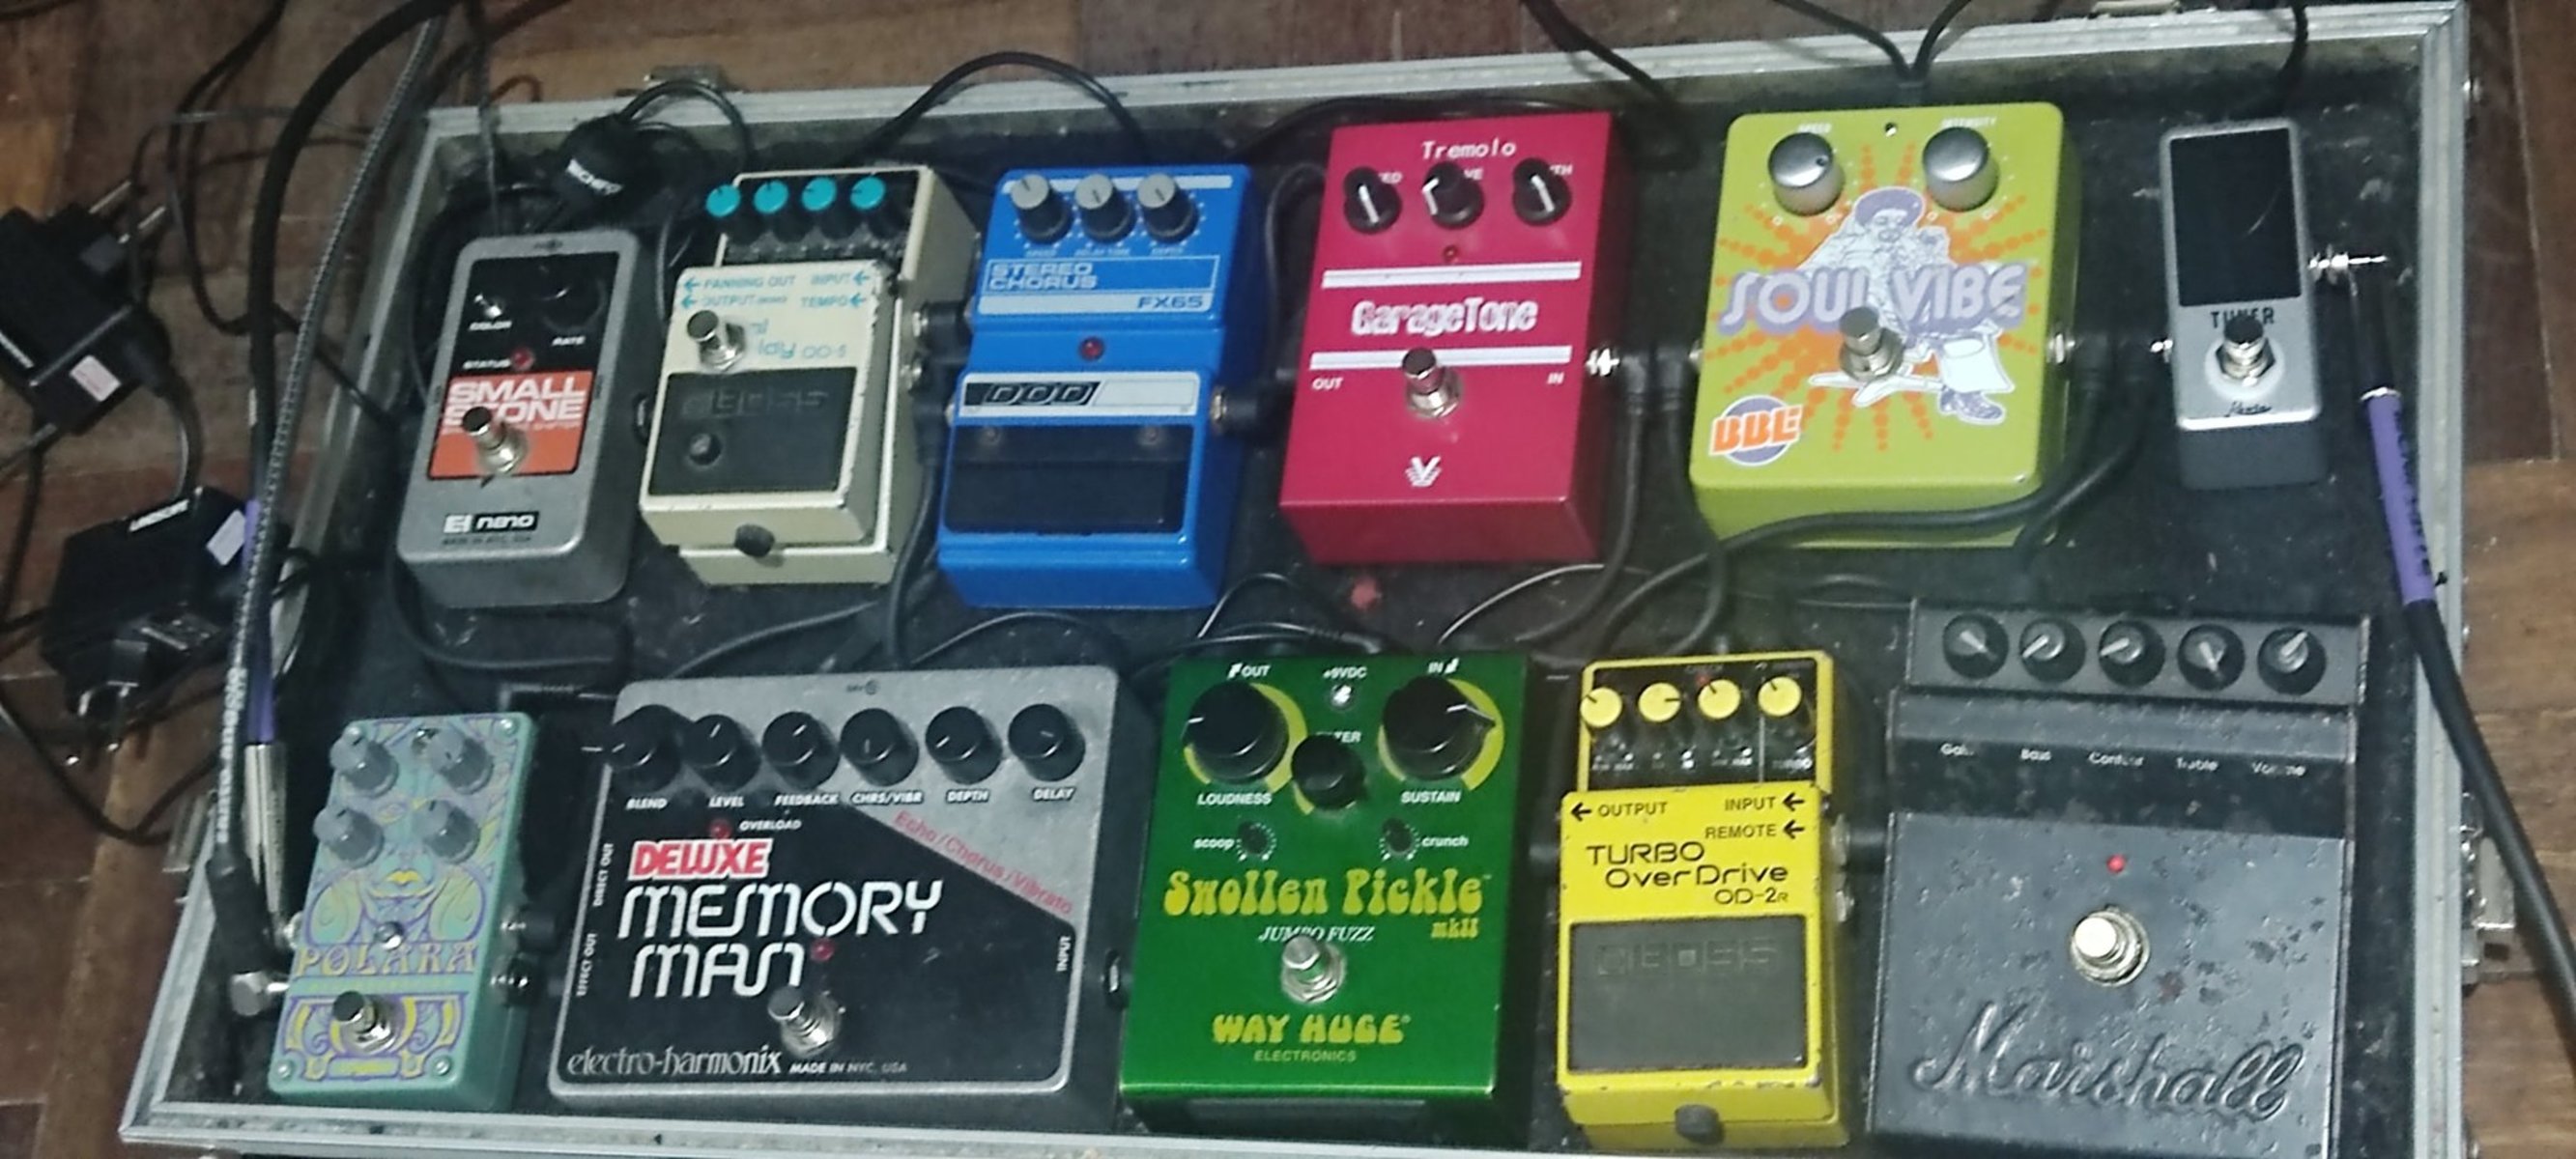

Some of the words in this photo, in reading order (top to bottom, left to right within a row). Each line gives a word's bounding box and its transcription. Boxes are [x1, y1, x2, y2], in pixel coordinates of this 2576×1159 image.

[1420, 137, 1517, 159] Tremolo
[991, 262, 1093, 276] STEREO
[988, 274, 1098, 290] CHORUS
[1137, 296, 1204, 309] FX65
[1889, 262, 2028, 334] VIBE
[1351, 296, 1538, 336] GarageTone
[1311, 377, 1344, 390] OUT
[1547, 372, 1564, 385] IN
[448, 377, 587, 406] SMALL
[1709, 405, 1804, 456] BBE
[1242, 664, 1272, 677] OUT
[1427, 662, 1444, 674] IN
[708, 795, 745, 808] LEVEL
[774, 793, 840, 806] FEEDBACK
[946, 789, 990, 803] DEPTH
[1032, 786, 1076, 801] DELAY
[1196, 792, 1273, 806] LOUDNESS
[1401, 790, 1462, 804] SUSTAIN
[625, 798, 669, 810] BLEND
[1597, 801, 1669, 818] OUTPUT
[1724, 796, 1777, 811] INPUT
[1704, 823, 1777, 839] REMOTE
[1193, 838, 1235, 851] scoop
[1420, 834, 1470, 848] crunch
[629, 838, 772, 881] DELUXE
[1586, 841, 1705, 866] TURBO
[1163, 868, 1329, 916] Swollen
[1341, 867, 1483, 916] Pickle
[616, 879, 944, 939] MEMORY
[1258, 925, 1325, 943] JUMO
[1326, 925, 1376, 942] FUZZ
[293, 943, 479, 976] POLARA
[629, 941, 806, 999] MAN
[1212, 1014, 1290, 1043] WAY
[566, 1044, 782, 1076] electro-harmonix
[1253, 1050, 1358, 1062] ELECTRONICS
[1912, 1001, 2304, 1122] Marshall
